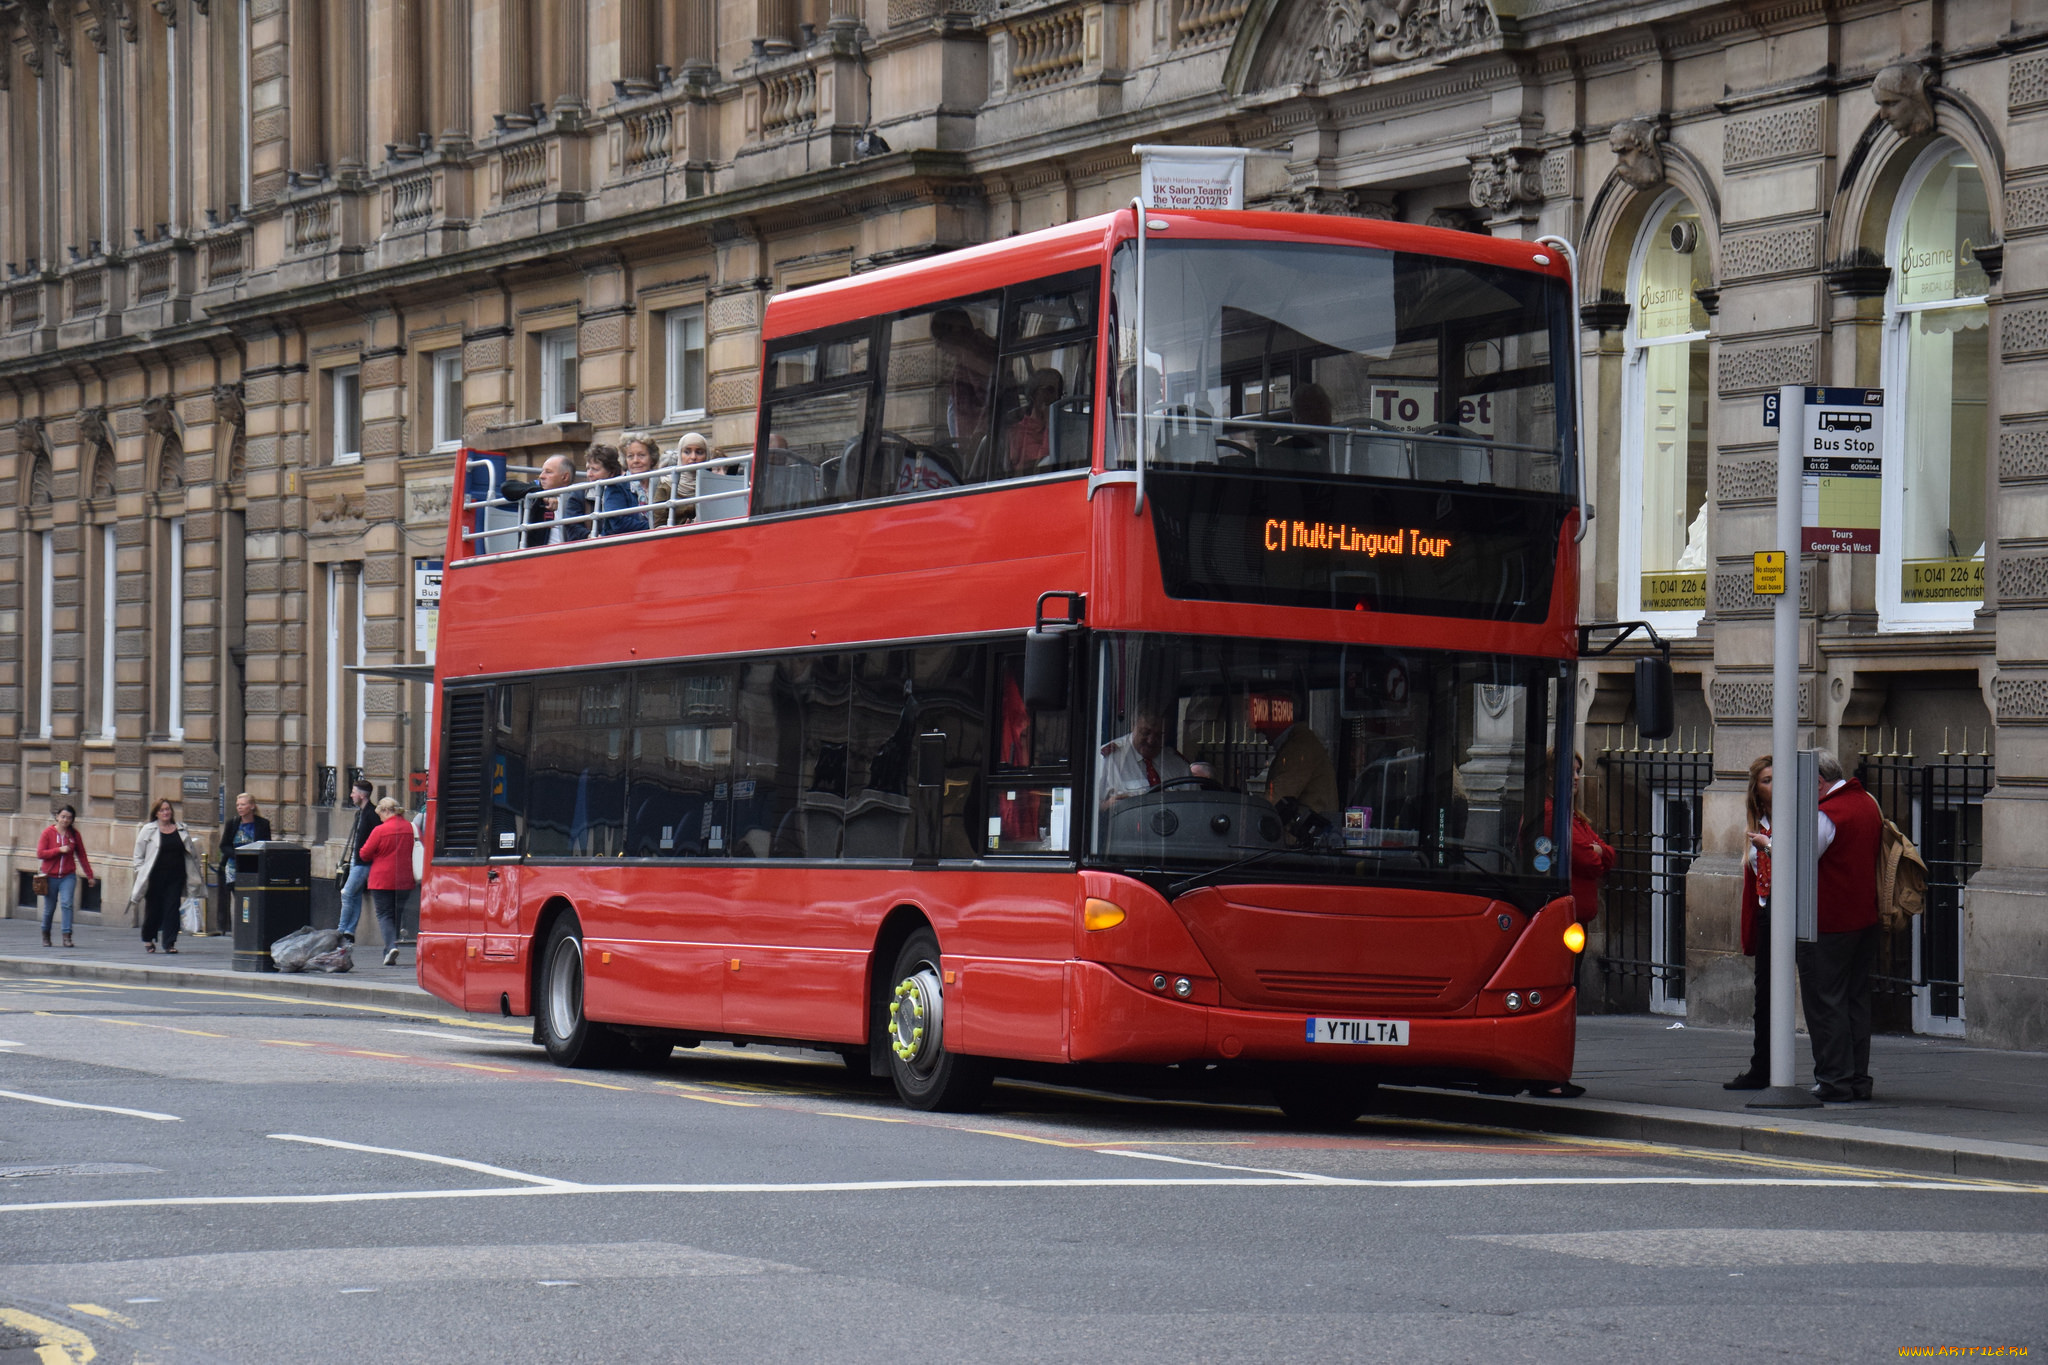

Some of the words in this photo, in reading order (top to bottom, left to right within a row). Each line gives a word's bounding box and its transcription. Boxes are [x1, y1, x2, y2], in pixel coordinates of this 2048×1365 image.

[1153, 184, 1166, 194] UK
[1169, 185, 1195, 194] Salon
[1197, 186, 1221, 195] Team
[1223, 186, 1232, 195] of
[1153, 194, 1167, 203] the
[1170, 195, 1190, 204] Year
[1193, 196, 1228, 206] 2012/13
[1902, 247, 1953, 274] Susanne
[1640, 286, 1684, 310] Susanne
[1376, 390, 1420, 421] To
[1434, 392, 1491, 424] et
[1814, 438, 1840, 450] Bus
[1844, 438, 1875, 453] Stop
[1265, 519, 1287, 551] C1
[1292, 521, 1403, 557] Multi-Lingual
[1410, 529, 1451, 557] Tour
[1832, 530, 1853, 538] Tours
[1811, 542, 1840, 552] George
[1842, 543, 1852, 553] Sq
[1853, 543, 1872, 552] West
[1924, 568, 1945, 582] 0141
[1950, 567, 1969, 582] 226
[1660, 580, 1677, 593] 0141
[1681, 579, 1697, 593] 226
[1904, 585, 1985, 599] www.susannechrist
[1439, 831, 1444, 841] TO
[1365, 1023, 1398, 1041] LTA
